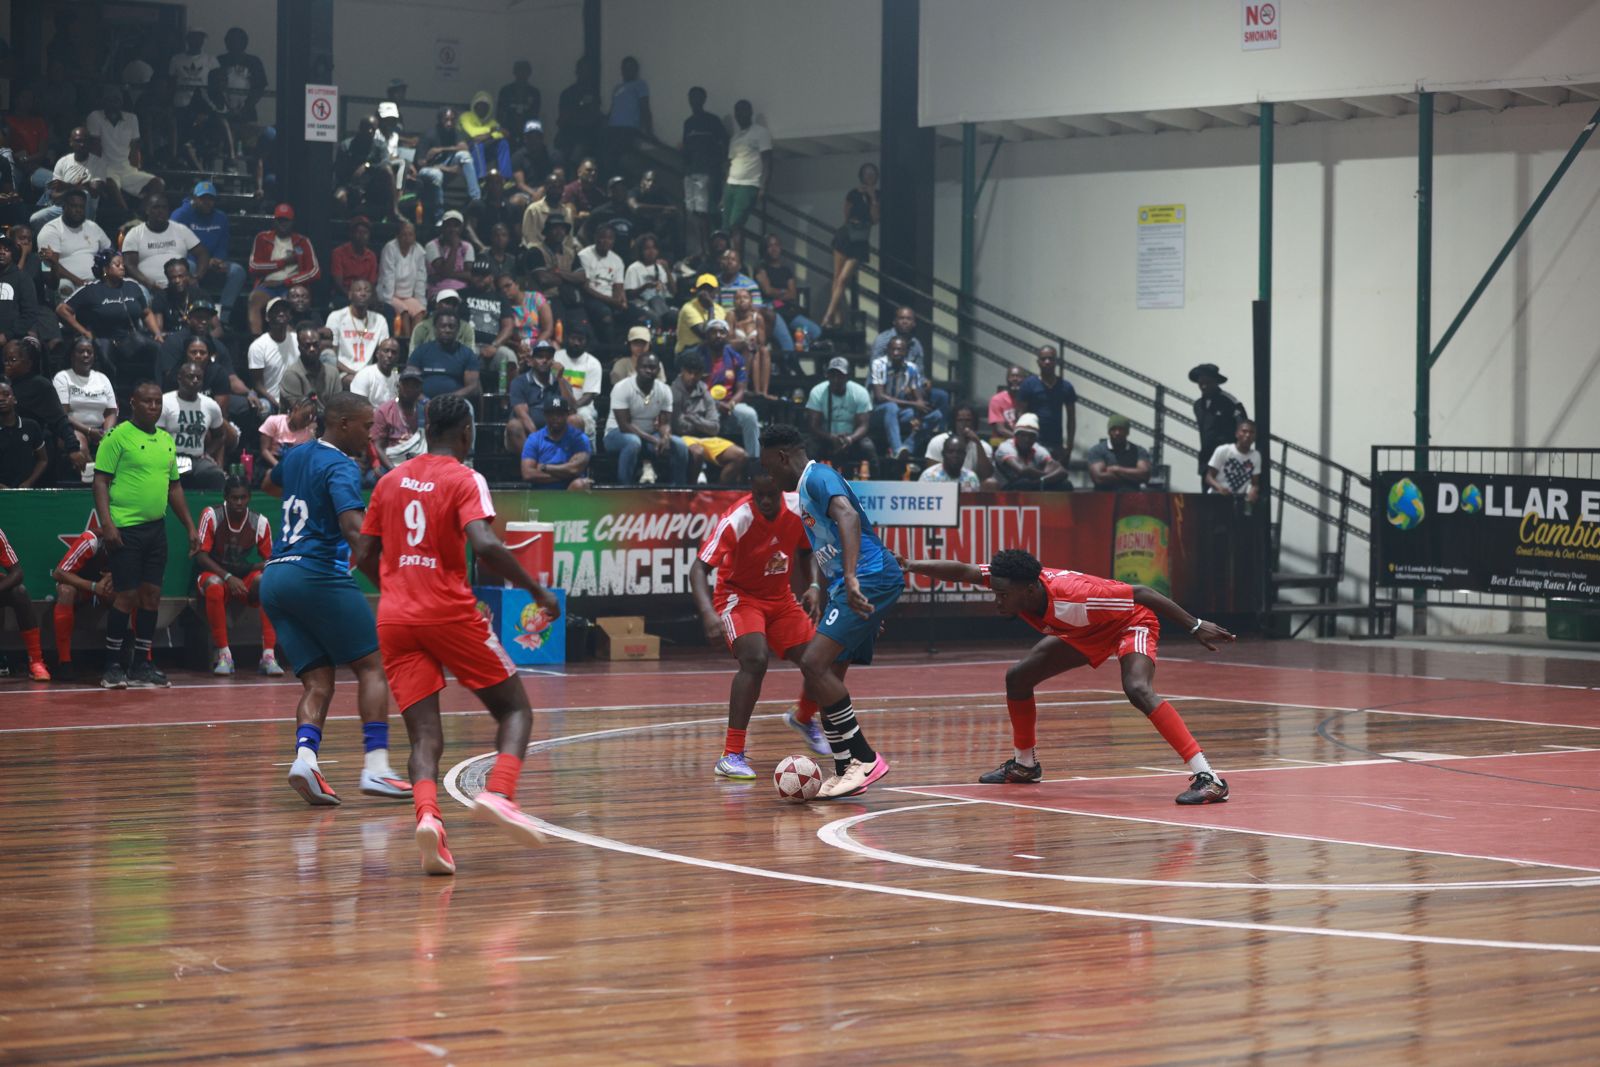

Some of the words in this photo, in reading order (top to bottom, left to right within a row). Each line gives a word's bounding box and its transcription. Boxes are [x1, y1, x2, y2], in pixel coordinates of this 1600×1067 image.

[1244, 30, 1277, 42] SMOKING
[353, 342, 365, 363] 11
[178, 410, 205, 424] AIR
[890, 495, 944, 511] STREET
[282, 494, 309, 545] 12
[404, 499, 426, 547] 9
[553, 520, 589, 544] THE
[553, 548, 718, 598] DANCEH
[1491, 575, 1508, 586] Best
[1508, 576, 1543, 591] Exchange
[1543, 579, 1565, 590] Rates
[1566, 581, 1577, 592] In
[825, 608, 839, 626] 9
